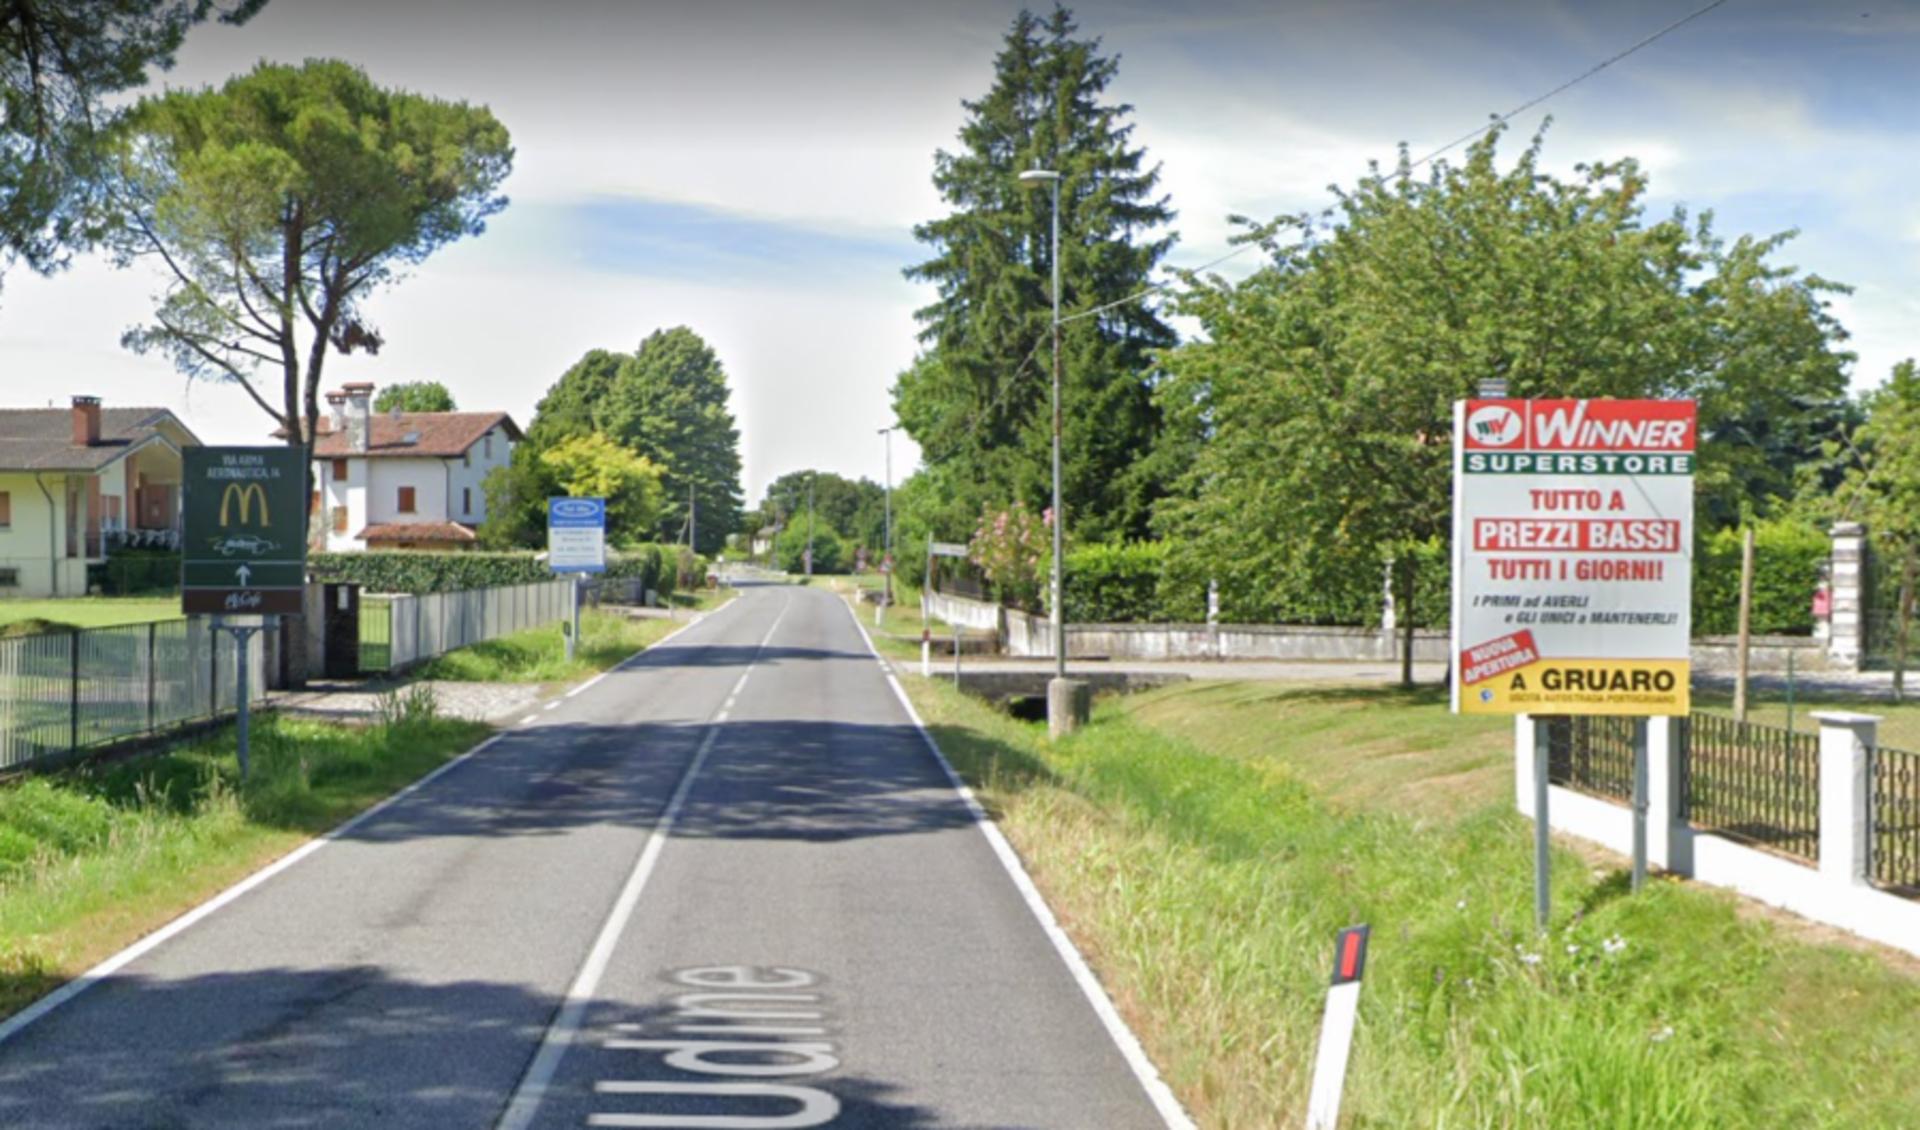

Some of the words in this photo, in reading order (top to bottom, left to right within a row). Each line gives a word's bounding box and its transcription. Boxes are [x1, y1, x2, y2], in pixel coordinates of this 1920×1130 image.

[1535, 401, 1687, 447] WINNER
[1468, 454, 1688, 473] SUPERSTORE
[1530, 489, 1601, 511] TUTTO
[1608, 490, 1625, 511] A
[1479, 521, 1578, 548] PREZZI
[1588, 522, 1674, 549] BASSI
[1487, 559, 1553, 580] TUTTI
[1559, 560, 1567, 580] I
[1576, 560, 1663, 581] GIORNI!
[1473, 596, 1480, 608] I
[1481, 596, 1521, 608] PRIMI
[1523, 596, 1540, 608] ad
[1543, 596, 1590, 608] AVERLI
[1504, 614, 1513, 624] e
[1516, 612, 1538, 624] GLI
[1539, 612, 1576, 624] UNICI
[1578, 614, 1586, 624] a
[1471, 636, 1518, 662] NUOVA
[1465, 648, 1535, 683] APERTURA
[1510, 672, 1526, 690] A
[1541, 669, 1675, 691] GRUARO
